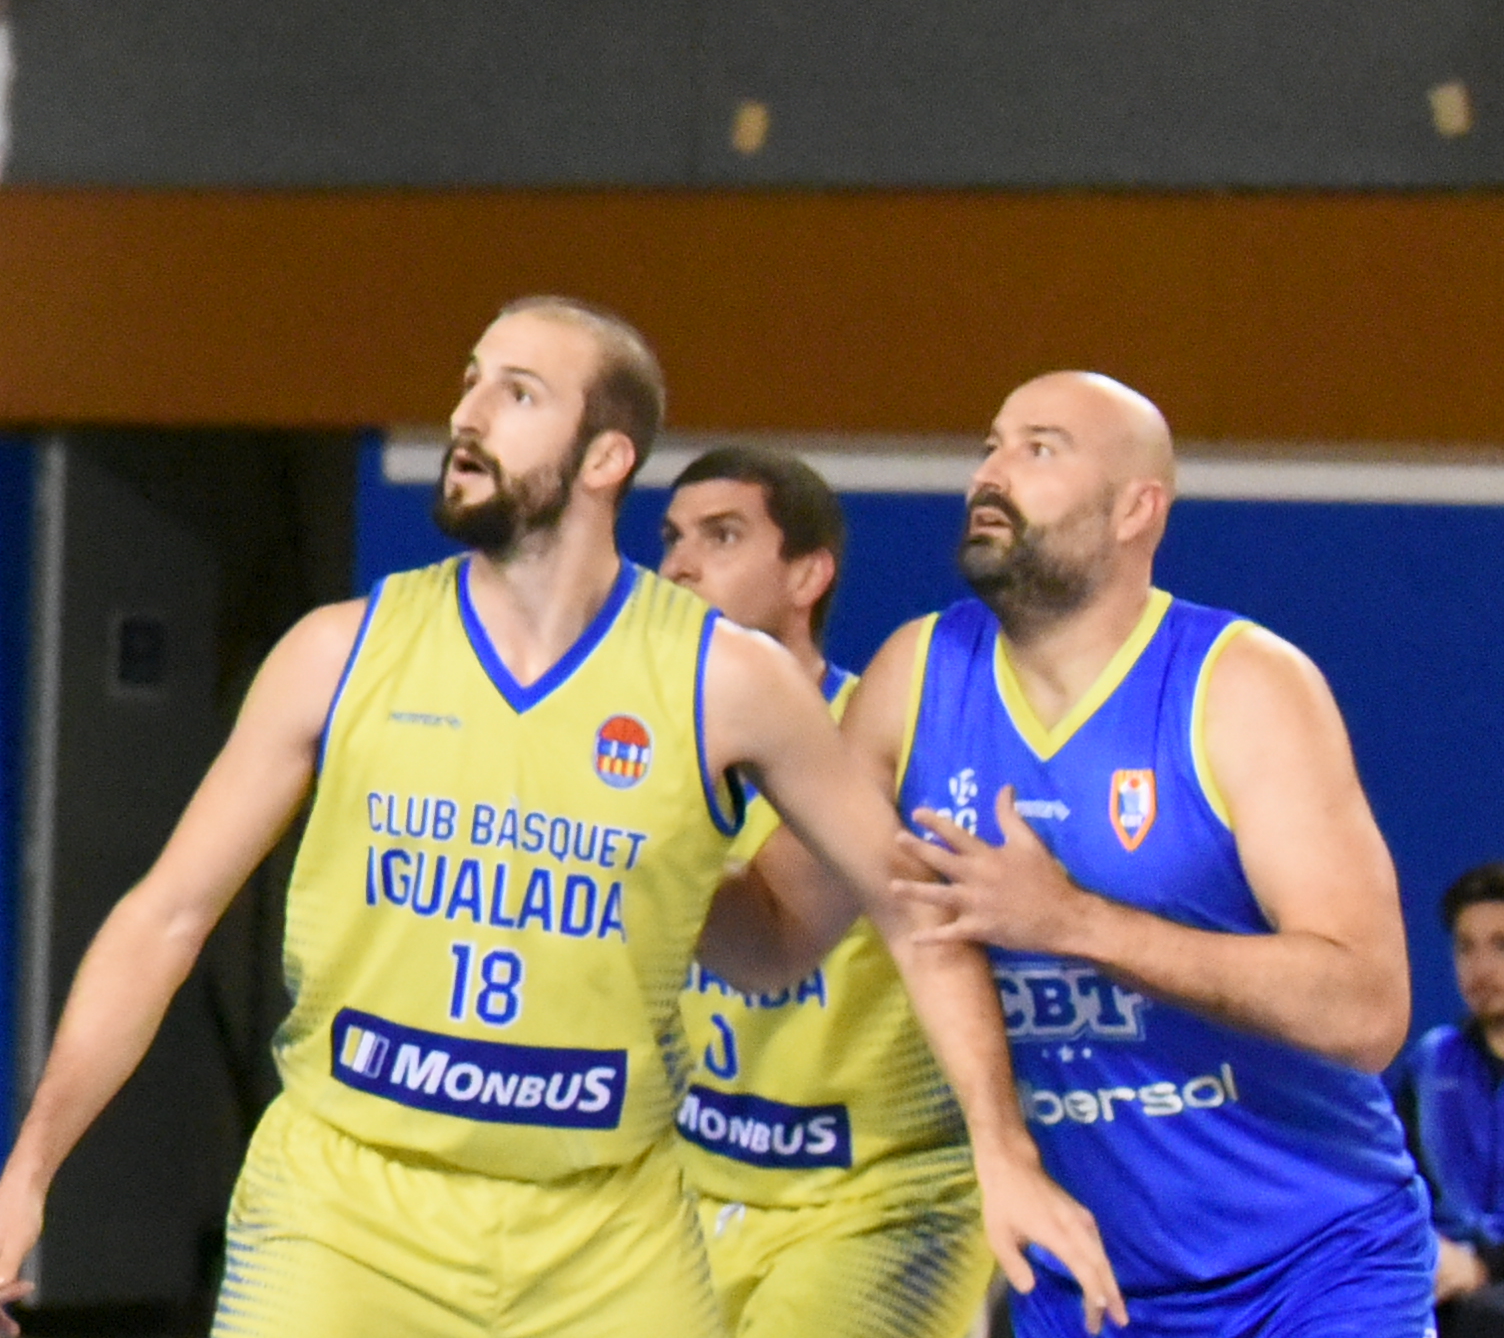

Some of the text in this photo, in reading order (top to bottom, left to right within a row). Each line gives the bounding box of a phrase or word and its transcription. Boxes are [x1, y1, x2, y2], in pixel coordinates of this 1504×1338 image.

[366, 791, 457, 842] CLUB
[365, 845, 628, 944] IGUALADA
[449, 943, 523, 1026] 18
[390, 1042, 617, 1113] MONBUS
